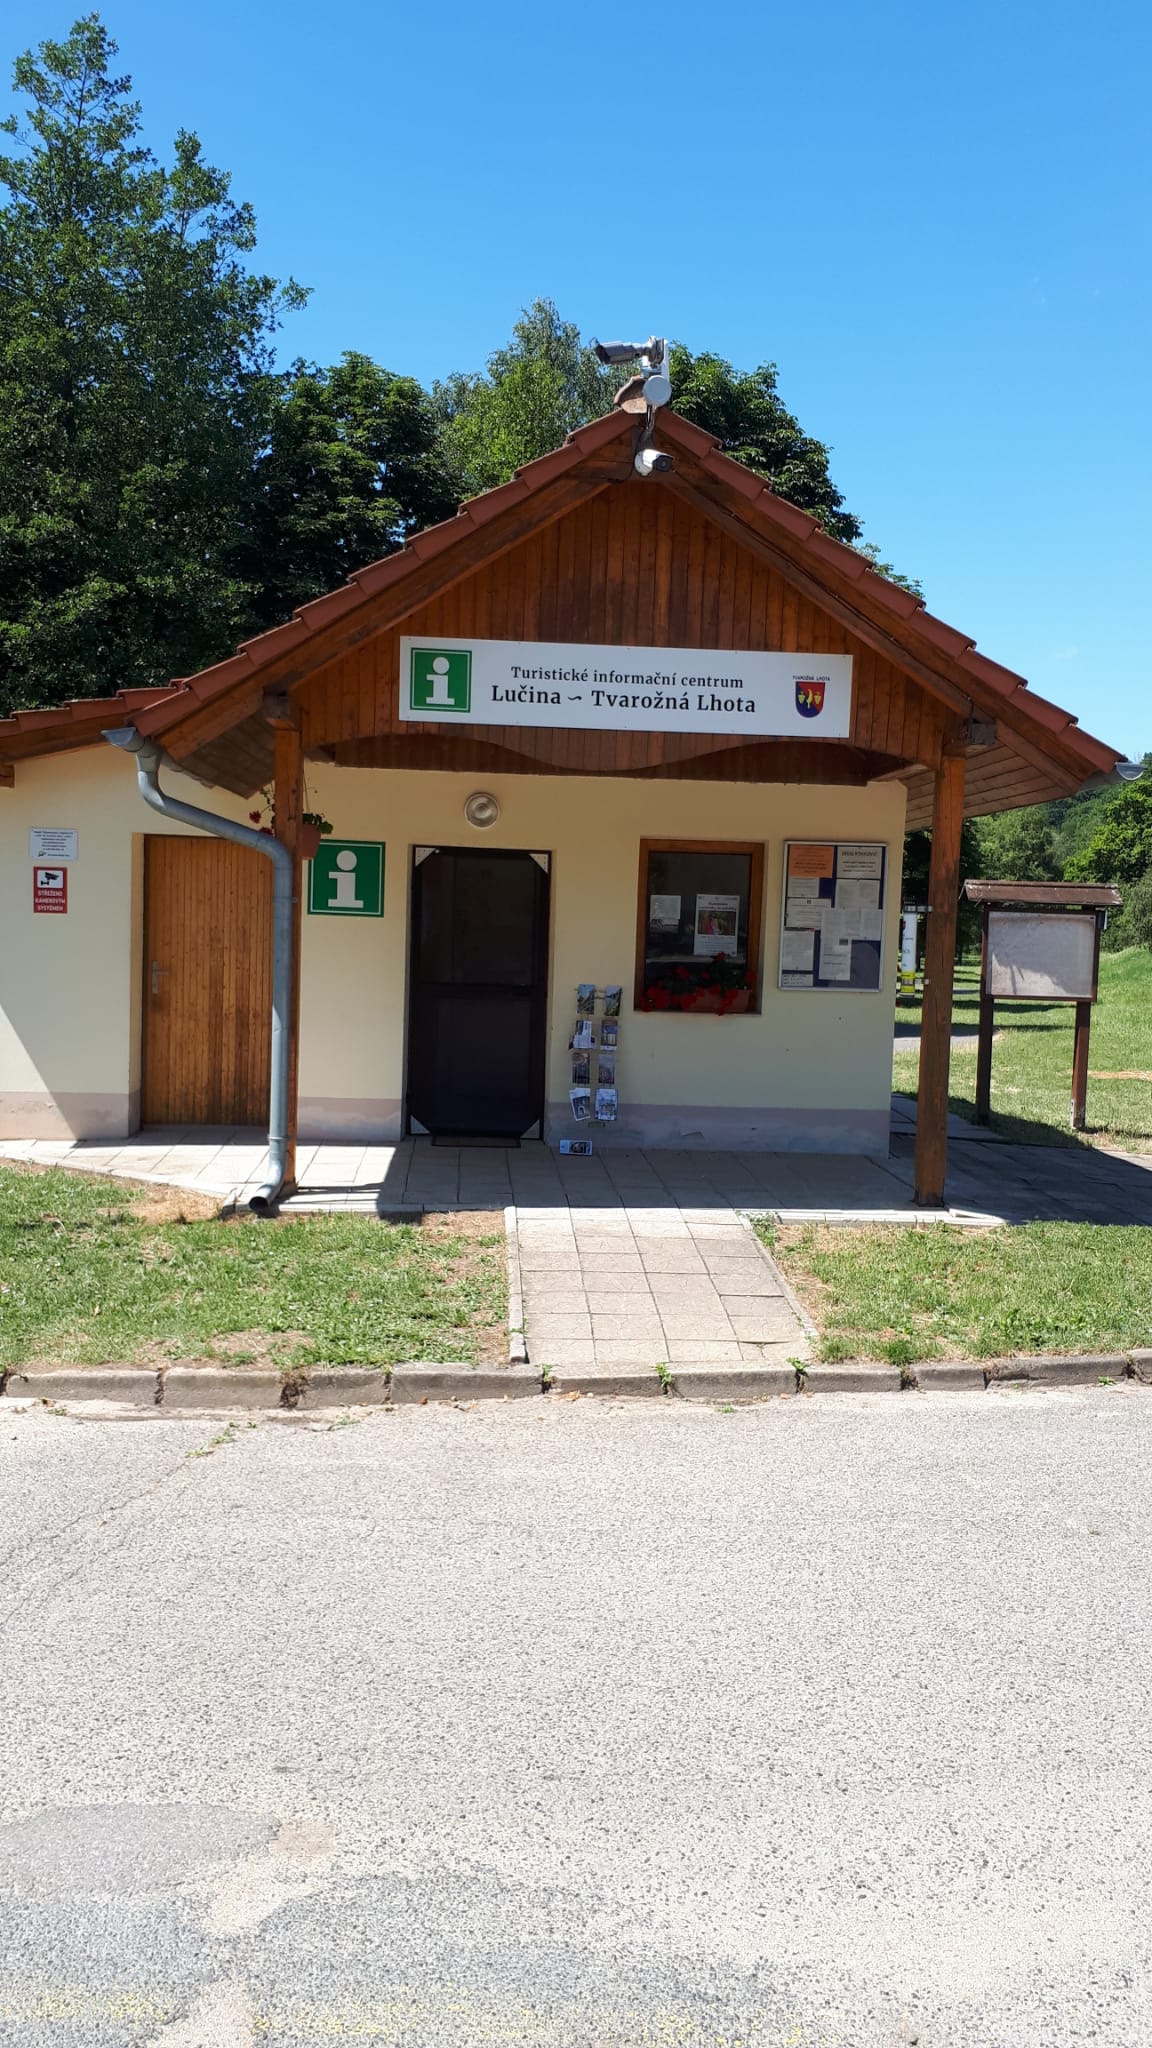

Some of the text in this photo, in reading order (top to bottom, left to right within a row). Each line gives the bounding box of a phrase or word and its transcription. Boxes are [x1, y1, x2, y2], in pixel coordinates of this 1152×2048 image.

[510, 666, 744, 689] Turistické informační centrum
[491, 684, 561, 705] Lučina
[591, 690, 690, 711] Tvarožná
[697, 694, 756, 713] Lhota
